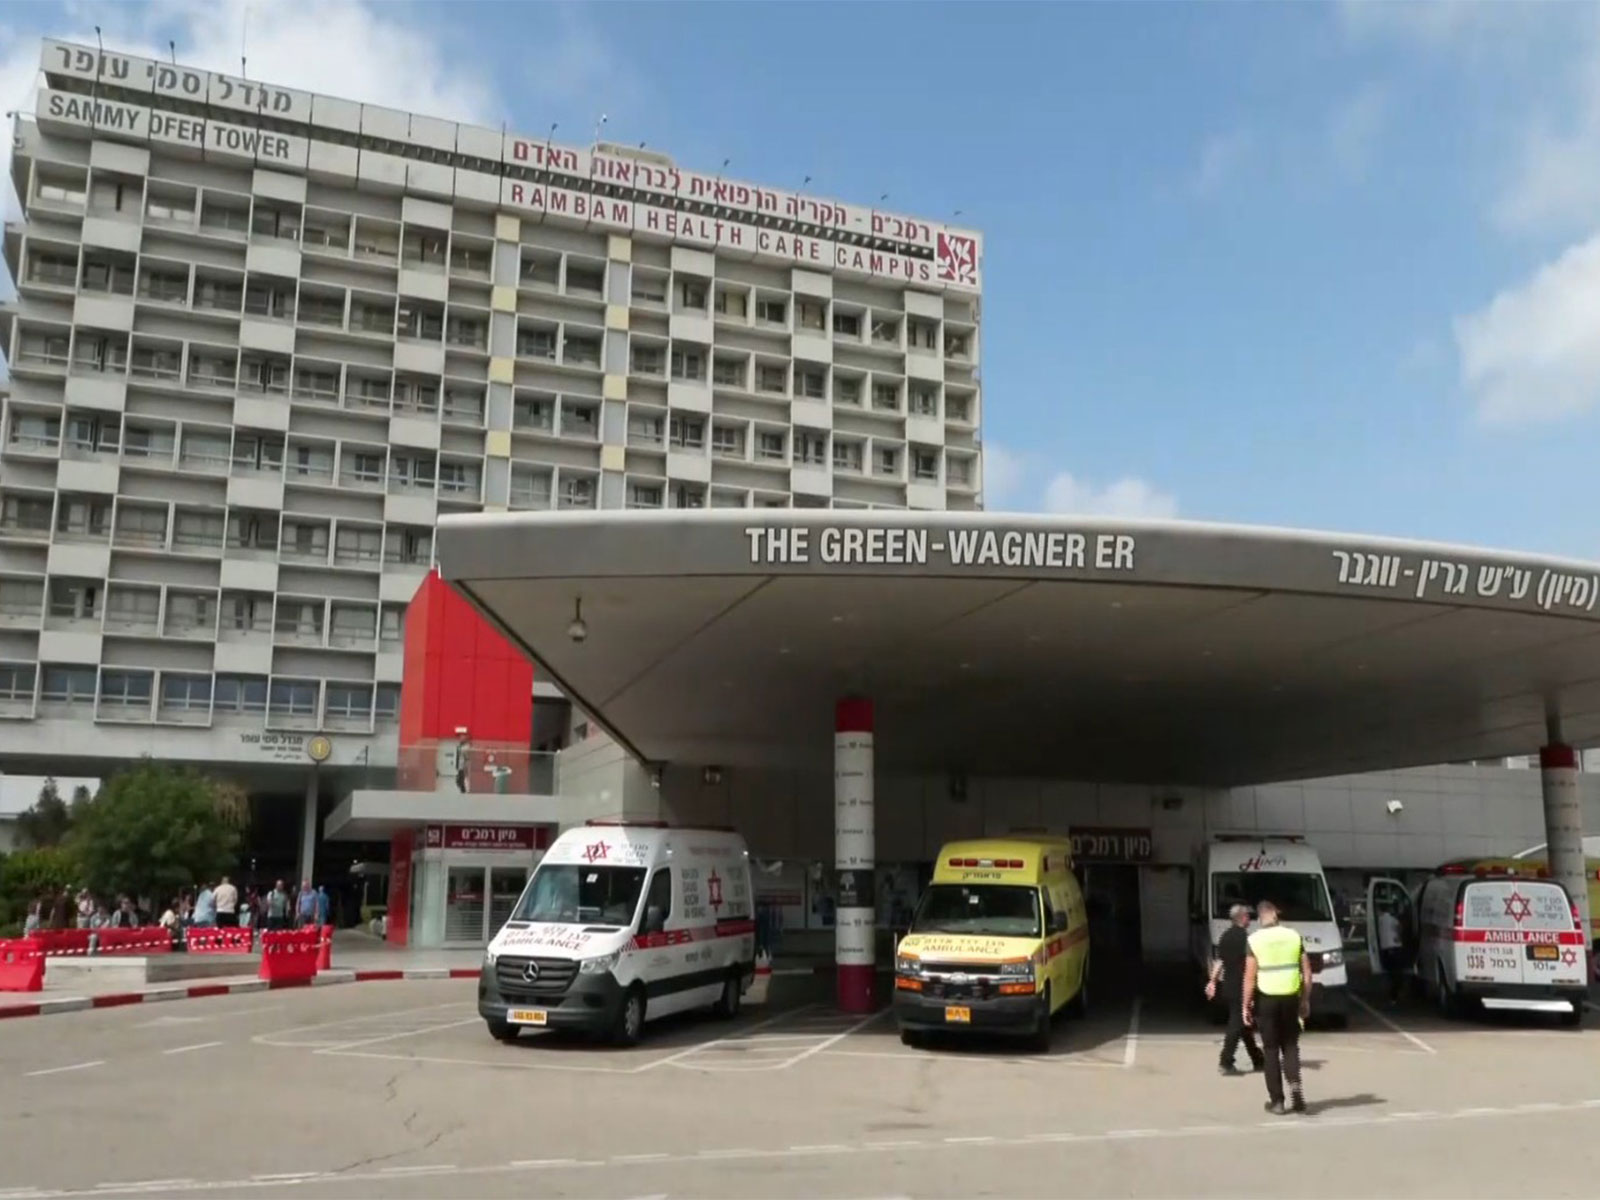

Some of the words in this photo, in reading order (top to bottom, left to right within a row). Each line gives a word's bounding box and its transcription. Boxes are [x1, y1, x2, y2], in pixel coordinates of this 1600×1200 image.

[56, 46, 129, 79] עופר
[147, 65, 201, 93] סמי
[217, 75, 292, 112] מגדל
[49, 95, 140, 130] SAMMY
[150, 113, 205, 142] OFER
[213, 126, 290, 159] TOWER
[513, 140, 578, 171] האדם
[592, 156, 680, 190] לבריאות
[690, 177, 777, 212] הרפואית
[787, 197, 847, 226] הקריה
[512, 184, 628, 223] RAMBAM
[648, 210, 742, 245] HEALTH
[759, 231, 820, 260] CARE
[837, 247, 930, 281] CAMPUS
[745, 528, 808, 563] THE
[820, 527, 1085, 568] GREEN-WAGNER
[1095, 534, 1135, 569] ER
[498, 828, 517, 842] מיון
[1124, 836, 1150, 860] מיון
[1484, 931, 1560, 944] AMBULANCE
[1490, 957, 1517, 969] כרמל
